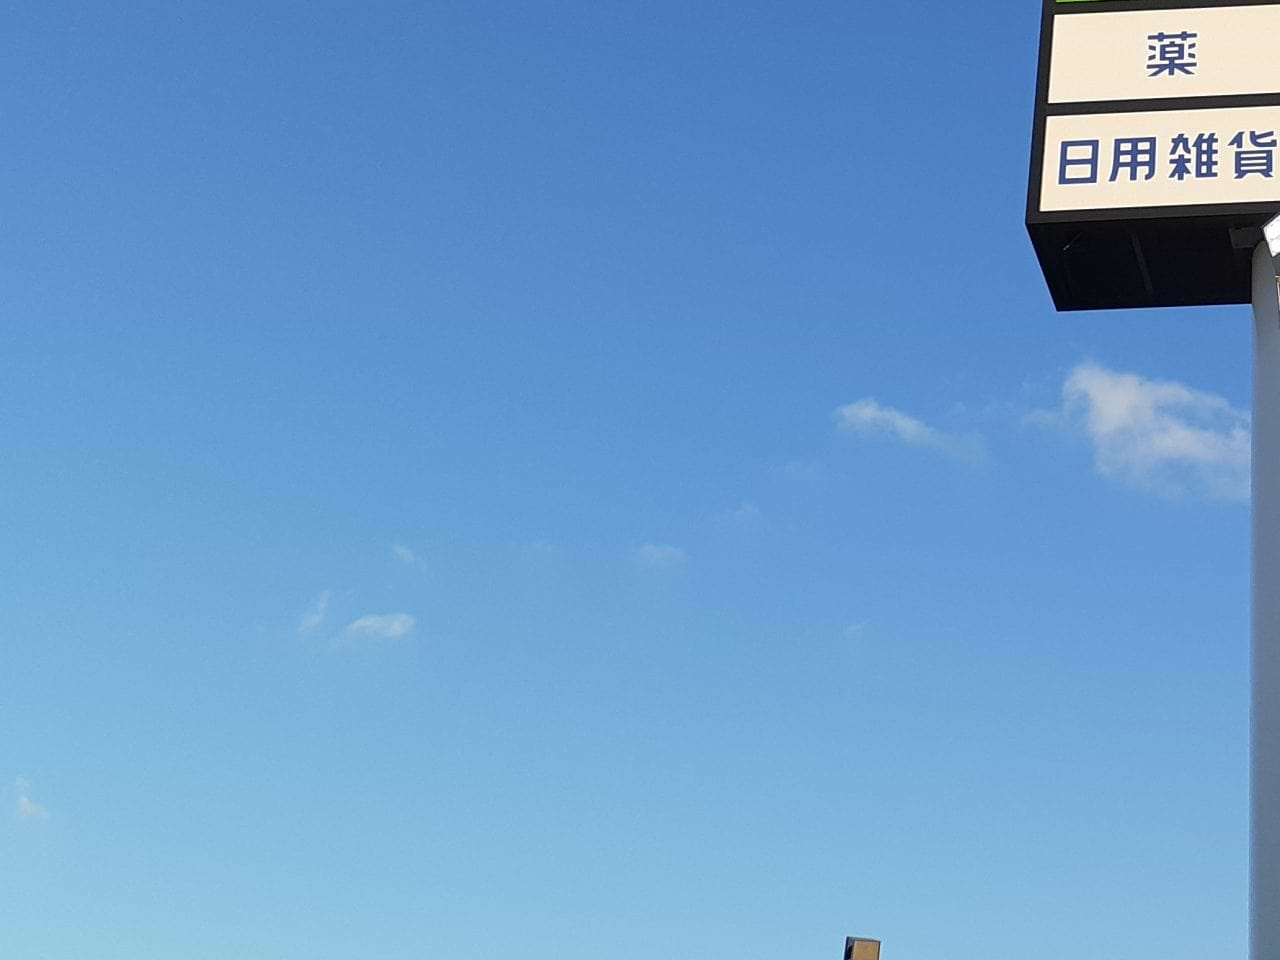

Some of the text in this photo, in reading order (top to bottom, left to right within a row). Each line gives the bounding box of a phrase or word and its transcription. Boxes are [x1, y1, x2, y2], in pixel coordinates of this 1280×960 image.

[1146, 30, 1198, 77] 薬
[1058, 130, 1278, 186] 日用雑貨
